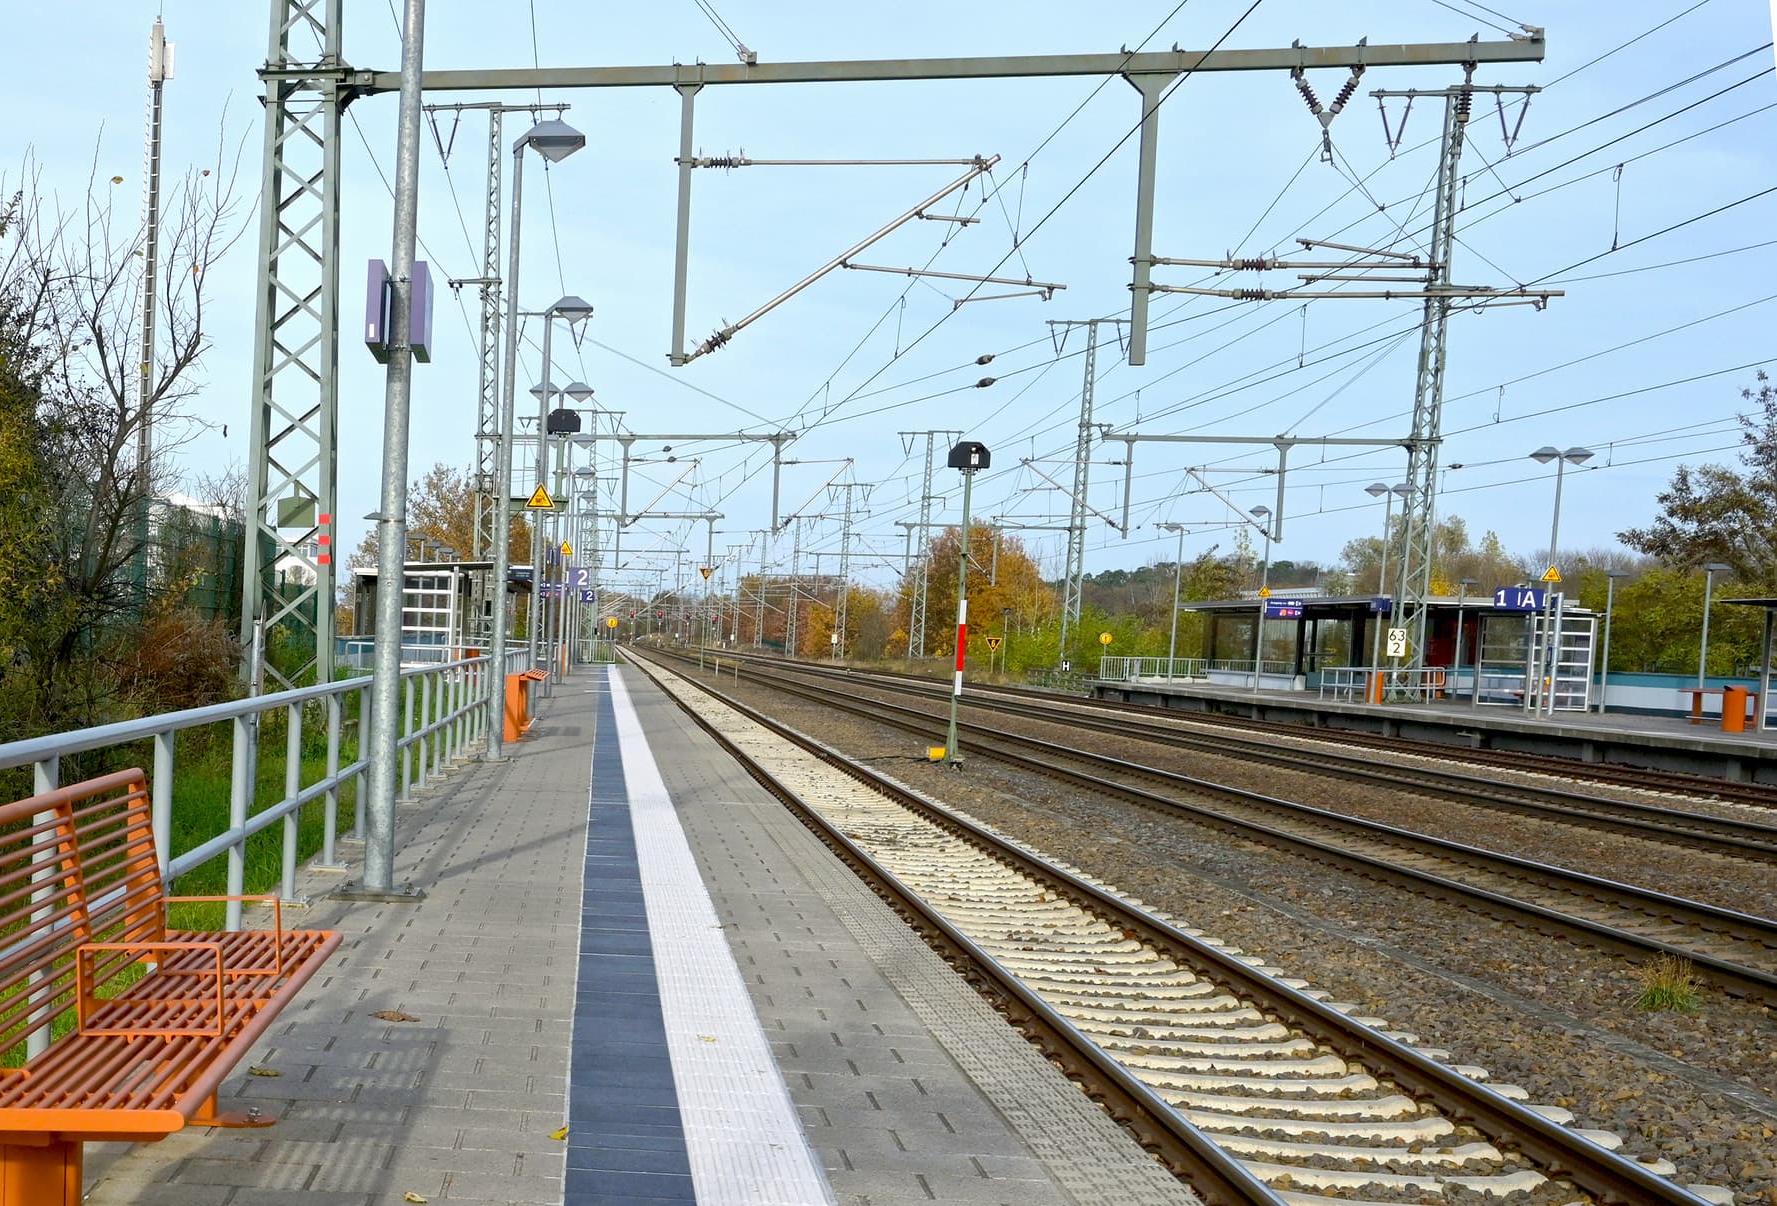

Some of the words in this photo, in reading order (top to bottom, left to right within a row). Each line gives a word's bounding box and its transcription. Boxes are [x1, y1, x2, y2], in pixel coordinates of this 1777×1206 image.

[577, 569, 588, 586] 2
[586, 590, 594, 601] 2
[1496, 589, 1507, 607] 1
[1521, 590, 1536, 608] A
[1389, 630, 1405, 641] 63
[1393, 642, 1400, 653] 2
[1062, 661, 1070, 671] H
